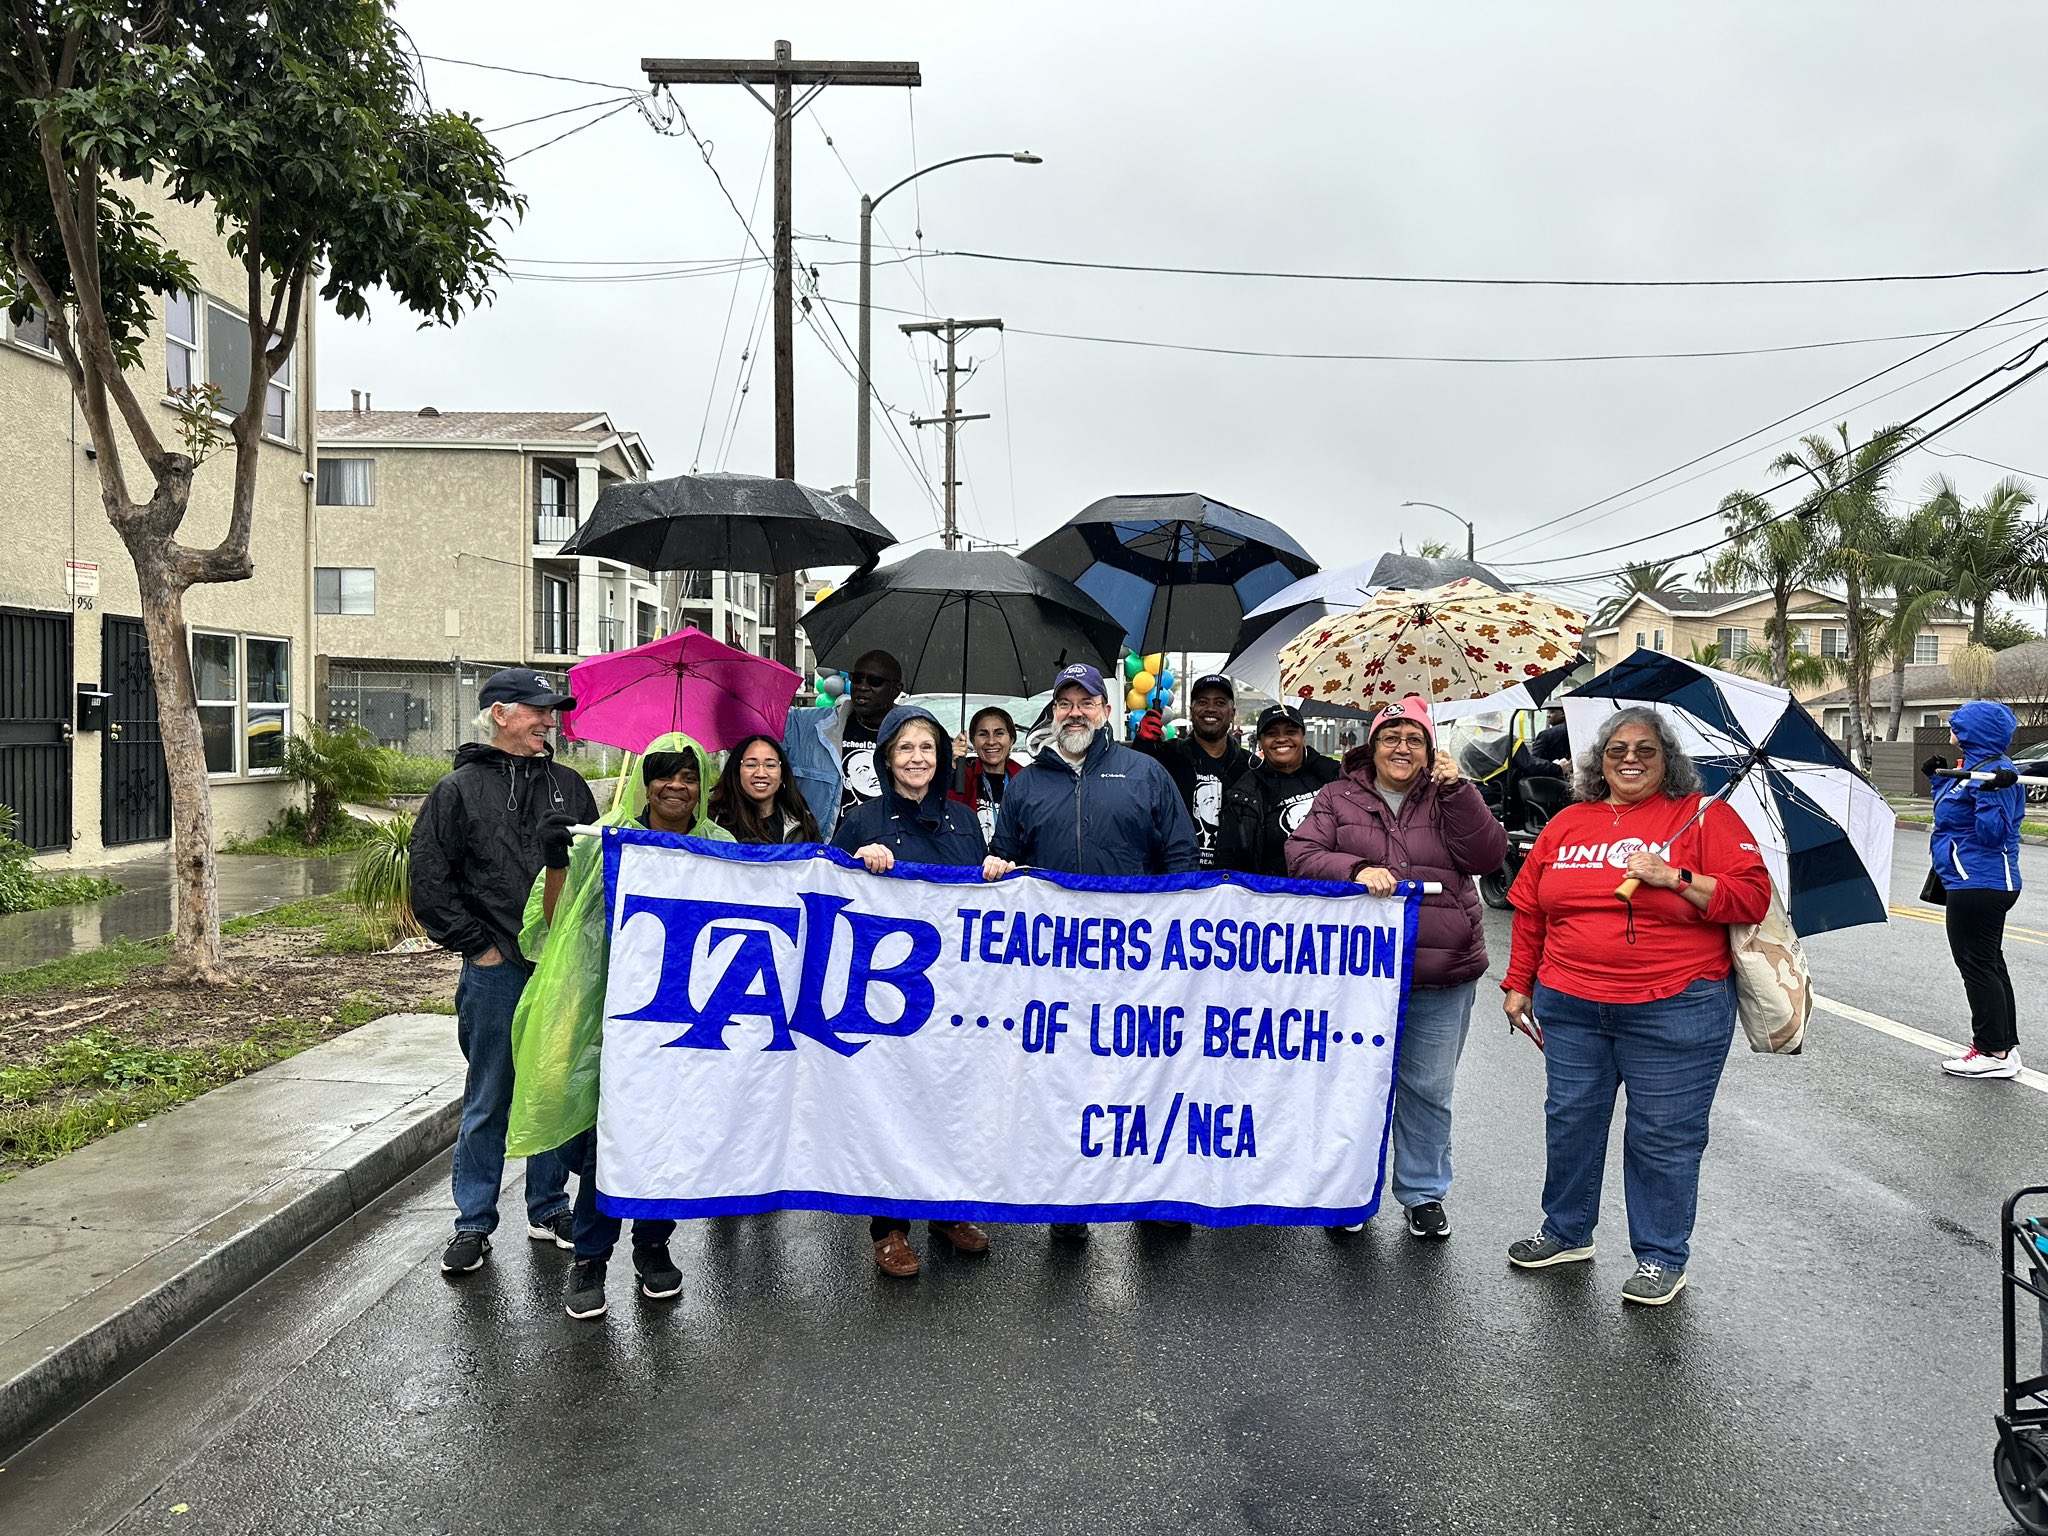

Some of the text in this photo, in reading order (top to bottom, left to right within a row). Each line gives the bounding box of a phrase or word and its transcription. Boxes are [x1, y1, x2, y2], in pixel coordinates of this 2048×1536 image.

[77, 596, 93, 611] 956
[842, 741, 867, 749] School
[608, 891, 942, 1058] TALB
[957, 908, 1397, 979] TEACHERS ASSOCIATION
[1089, 1003, 1185, 1058] LONG
[1080, 1092, 1257, 1165] CTA/NEA
